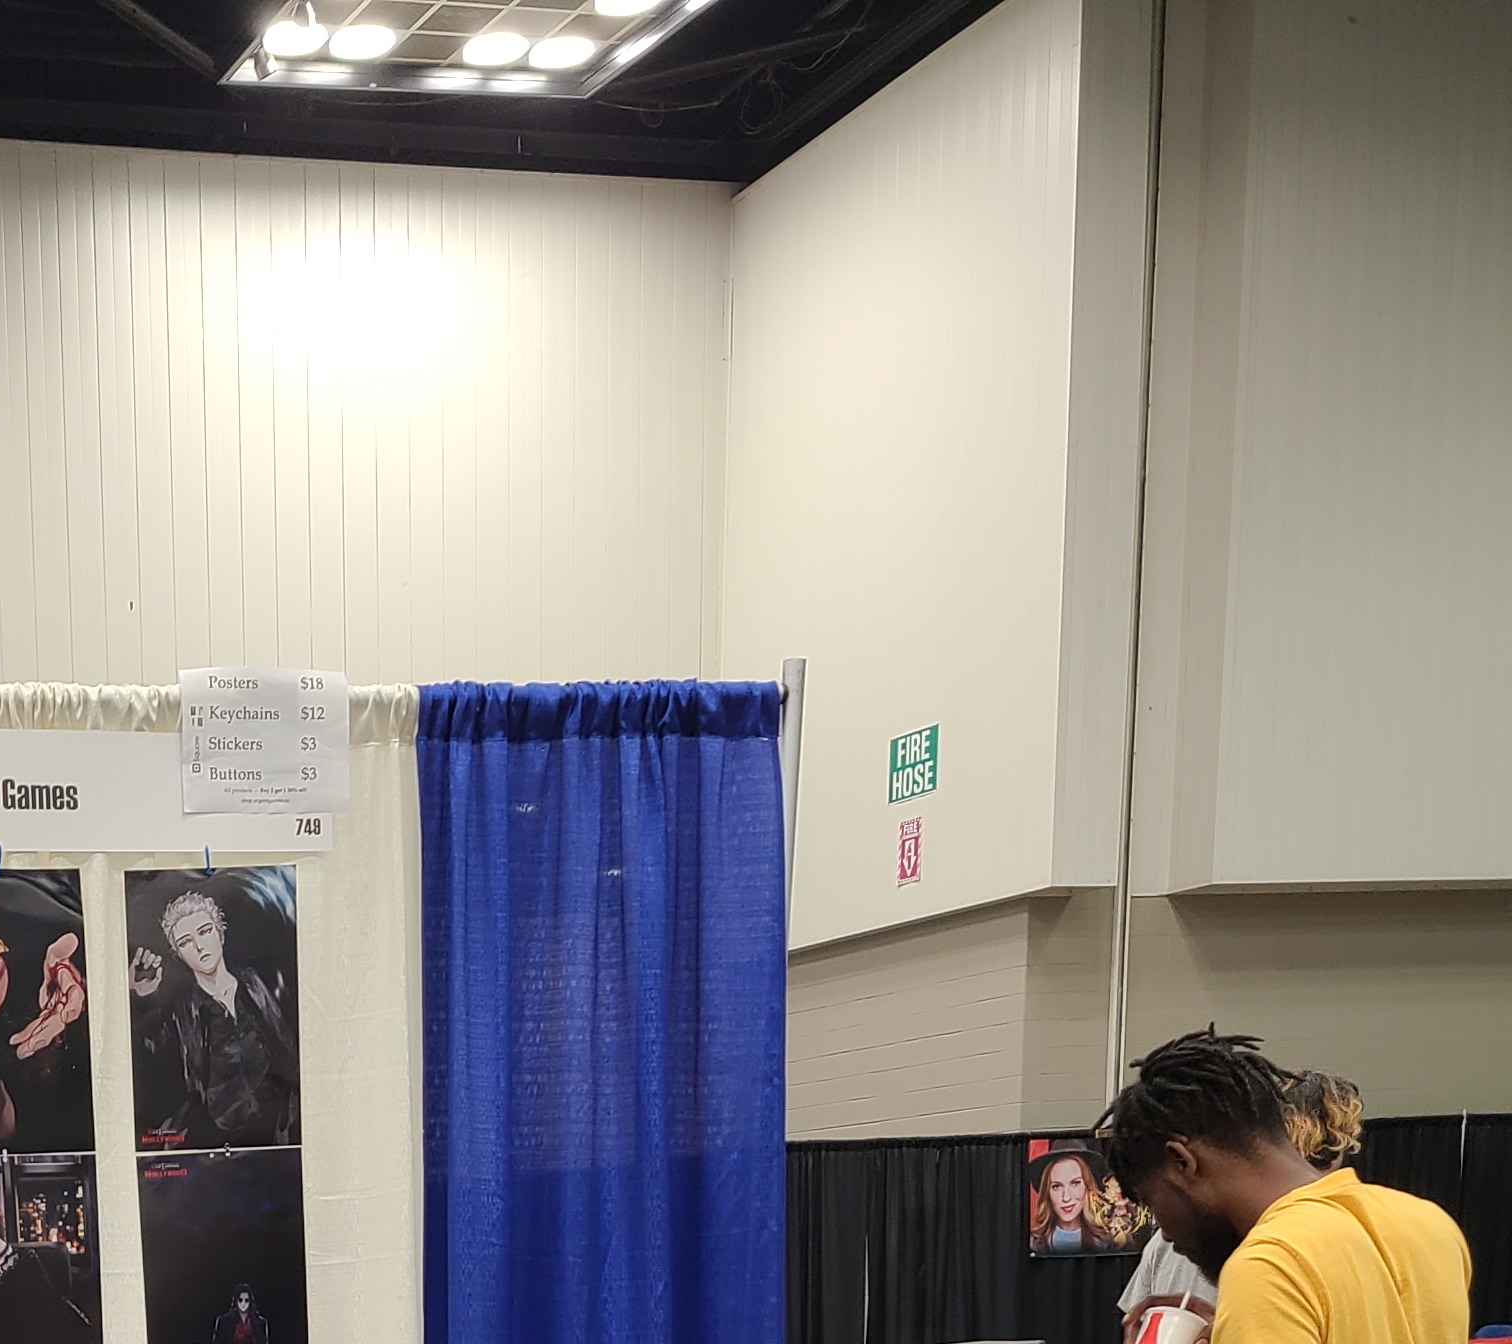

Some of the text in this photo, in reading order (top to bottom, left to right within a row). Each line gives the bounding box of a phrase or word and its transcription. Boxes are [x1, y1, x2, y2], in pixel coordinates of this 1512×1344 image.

[208, 675, 324, 690] Posters $18
[209, 705, 325, 724] Keychains $12
[208, 736, 317, 751] Stickers $3
[896, 729, 931, 768] FIRE
[209, 766, 317, 781] Buttons $3
[891, 760, 934, 801] HOSE
[2, 778, 79, 811] Games
